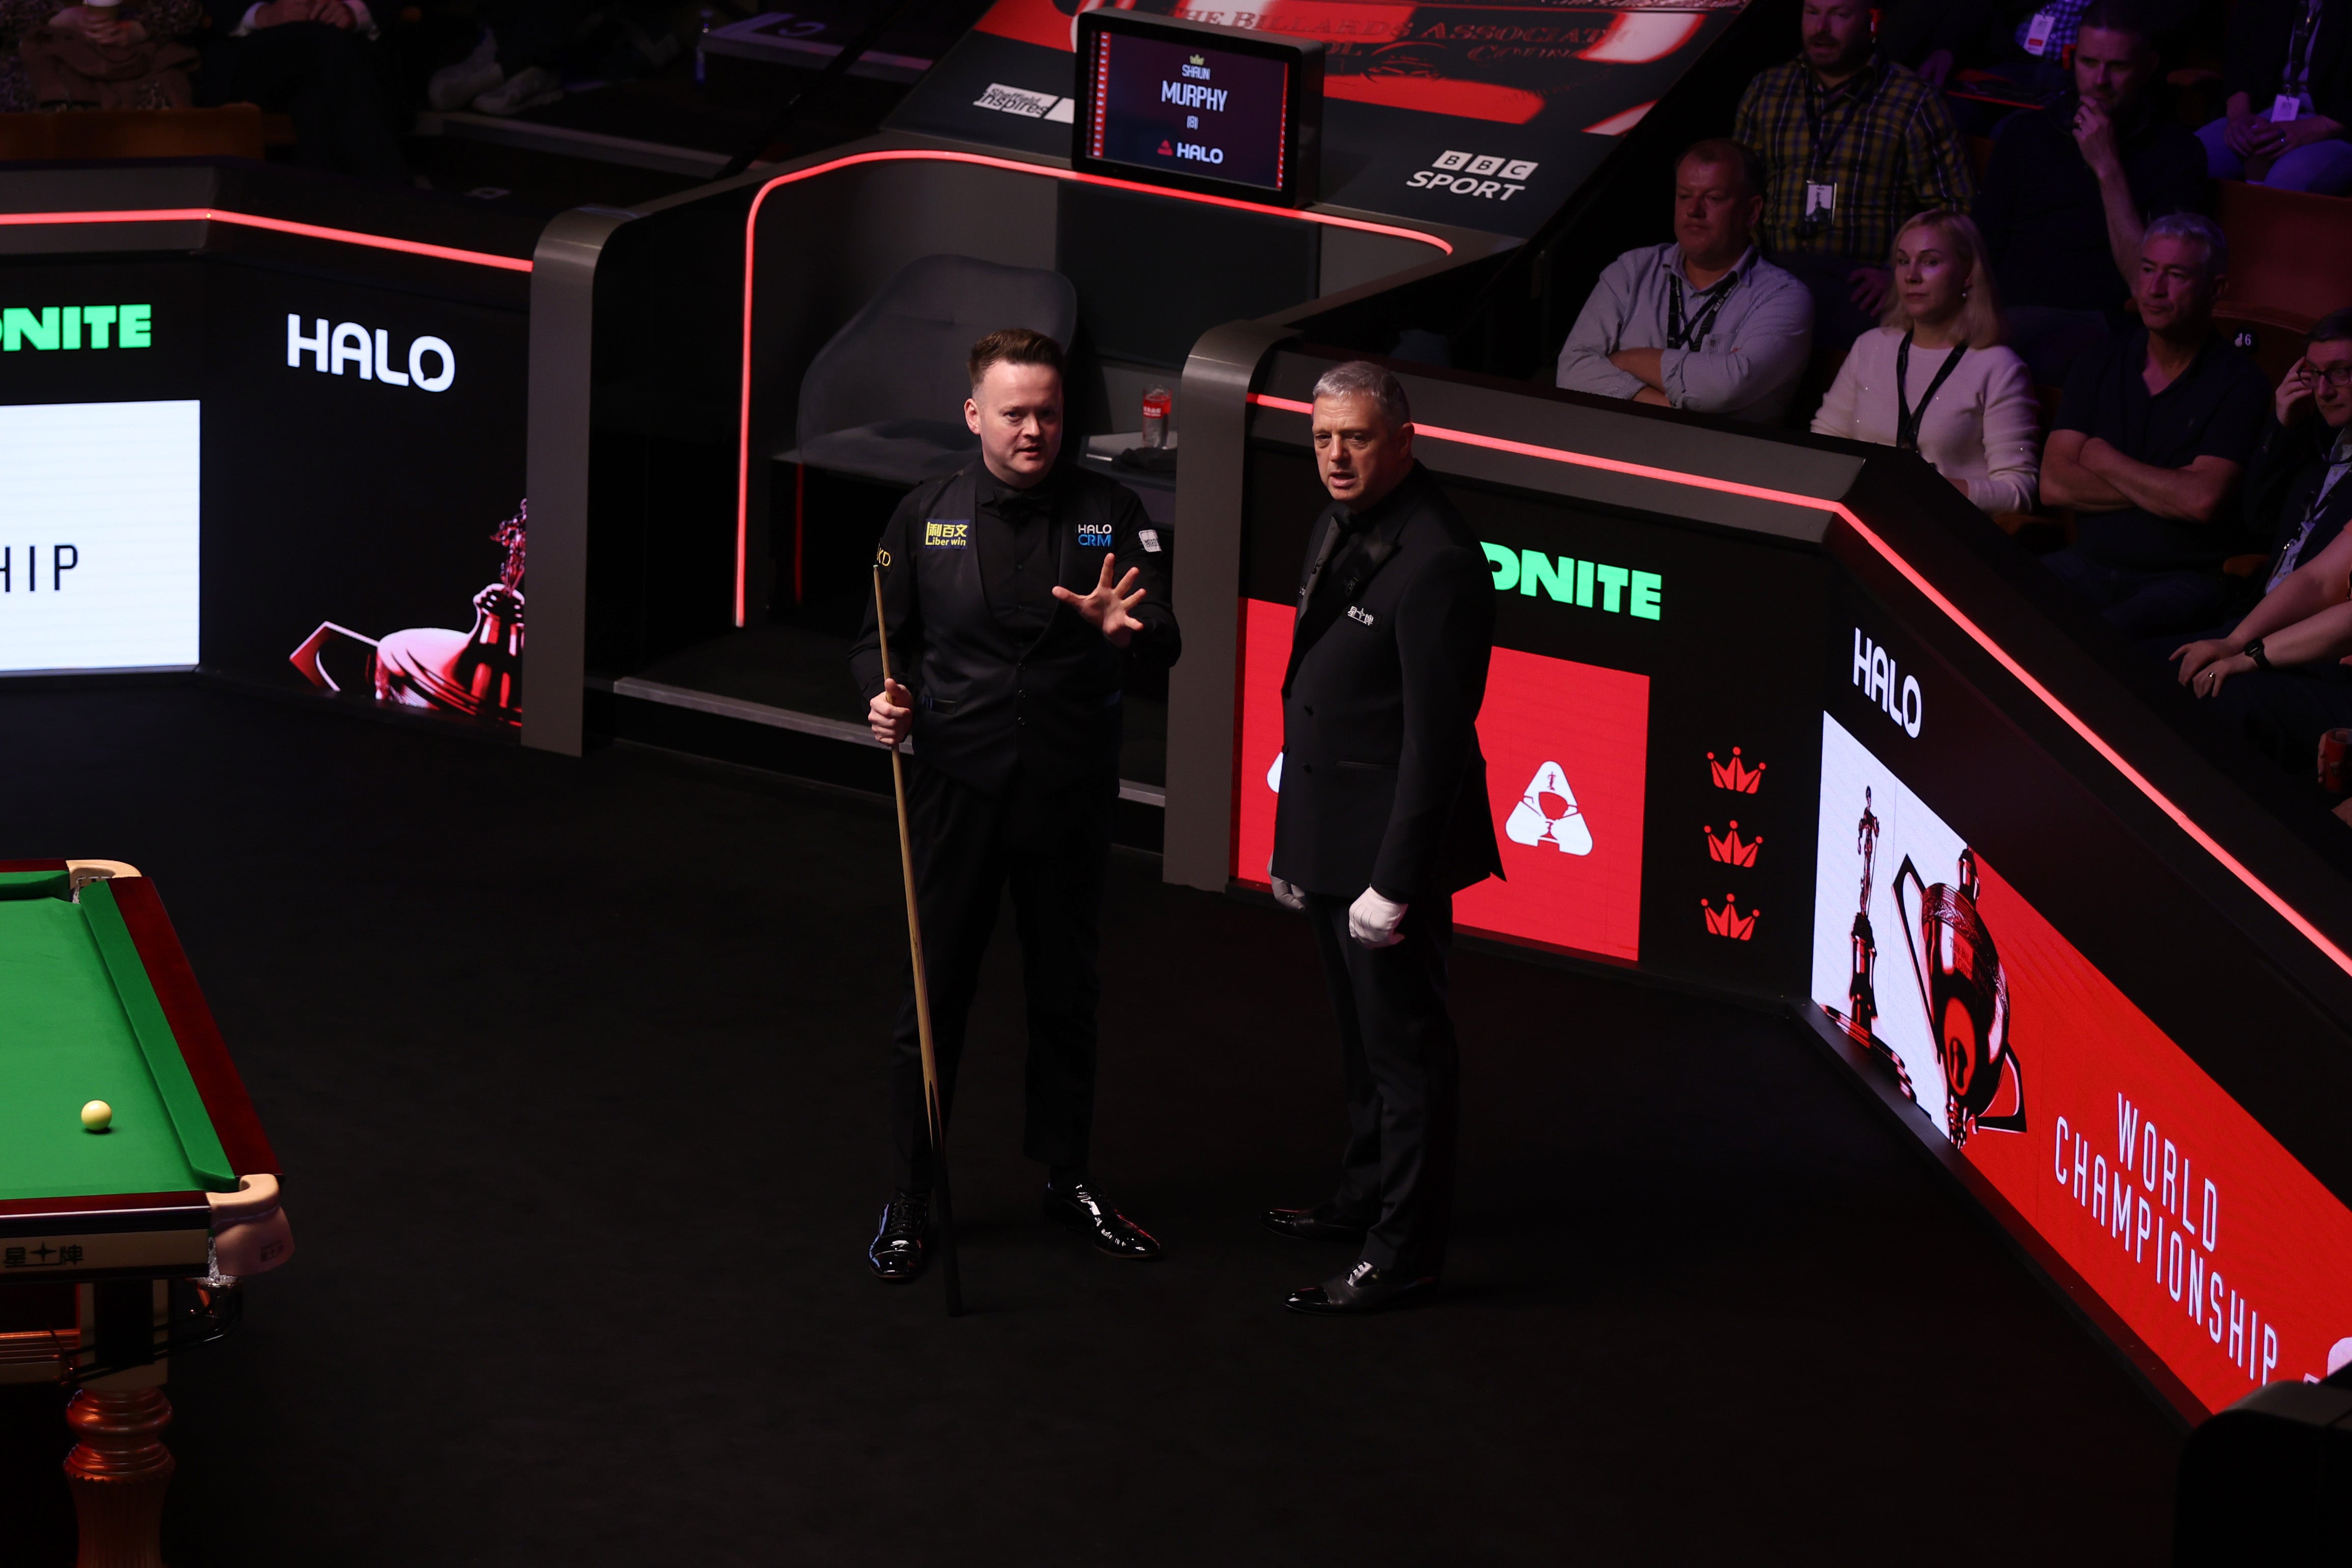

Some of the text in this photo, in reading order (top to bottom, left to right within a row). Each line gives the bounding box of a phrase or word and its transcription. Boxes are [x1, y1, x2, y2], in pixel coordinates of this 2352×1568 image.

[1181, 64, 1211, 80] SHAUN
[1161, 79, 1228, 112] MURPHY
[1176, 142, 1224, 165] HALO
[1439, 152, 1532, 178] BBC
[1406, 170, 1526, 201] SPORT
[0, 303, 152, 352] NITE
[287, 313, 456, 393] HALO
[925, 521, 966, 546] Liber win
[929, 523, 968, 538] 利百文
[1078, 524, 1112, 534] HALO
[1078, 534, 1112, 547] CRM
[1854, 627, 1922, 739] HALO
[2118, 1092, 2217, 1252] WORLD
[2055, 1116, 2277, 1387] CHAMPIONSHIP
